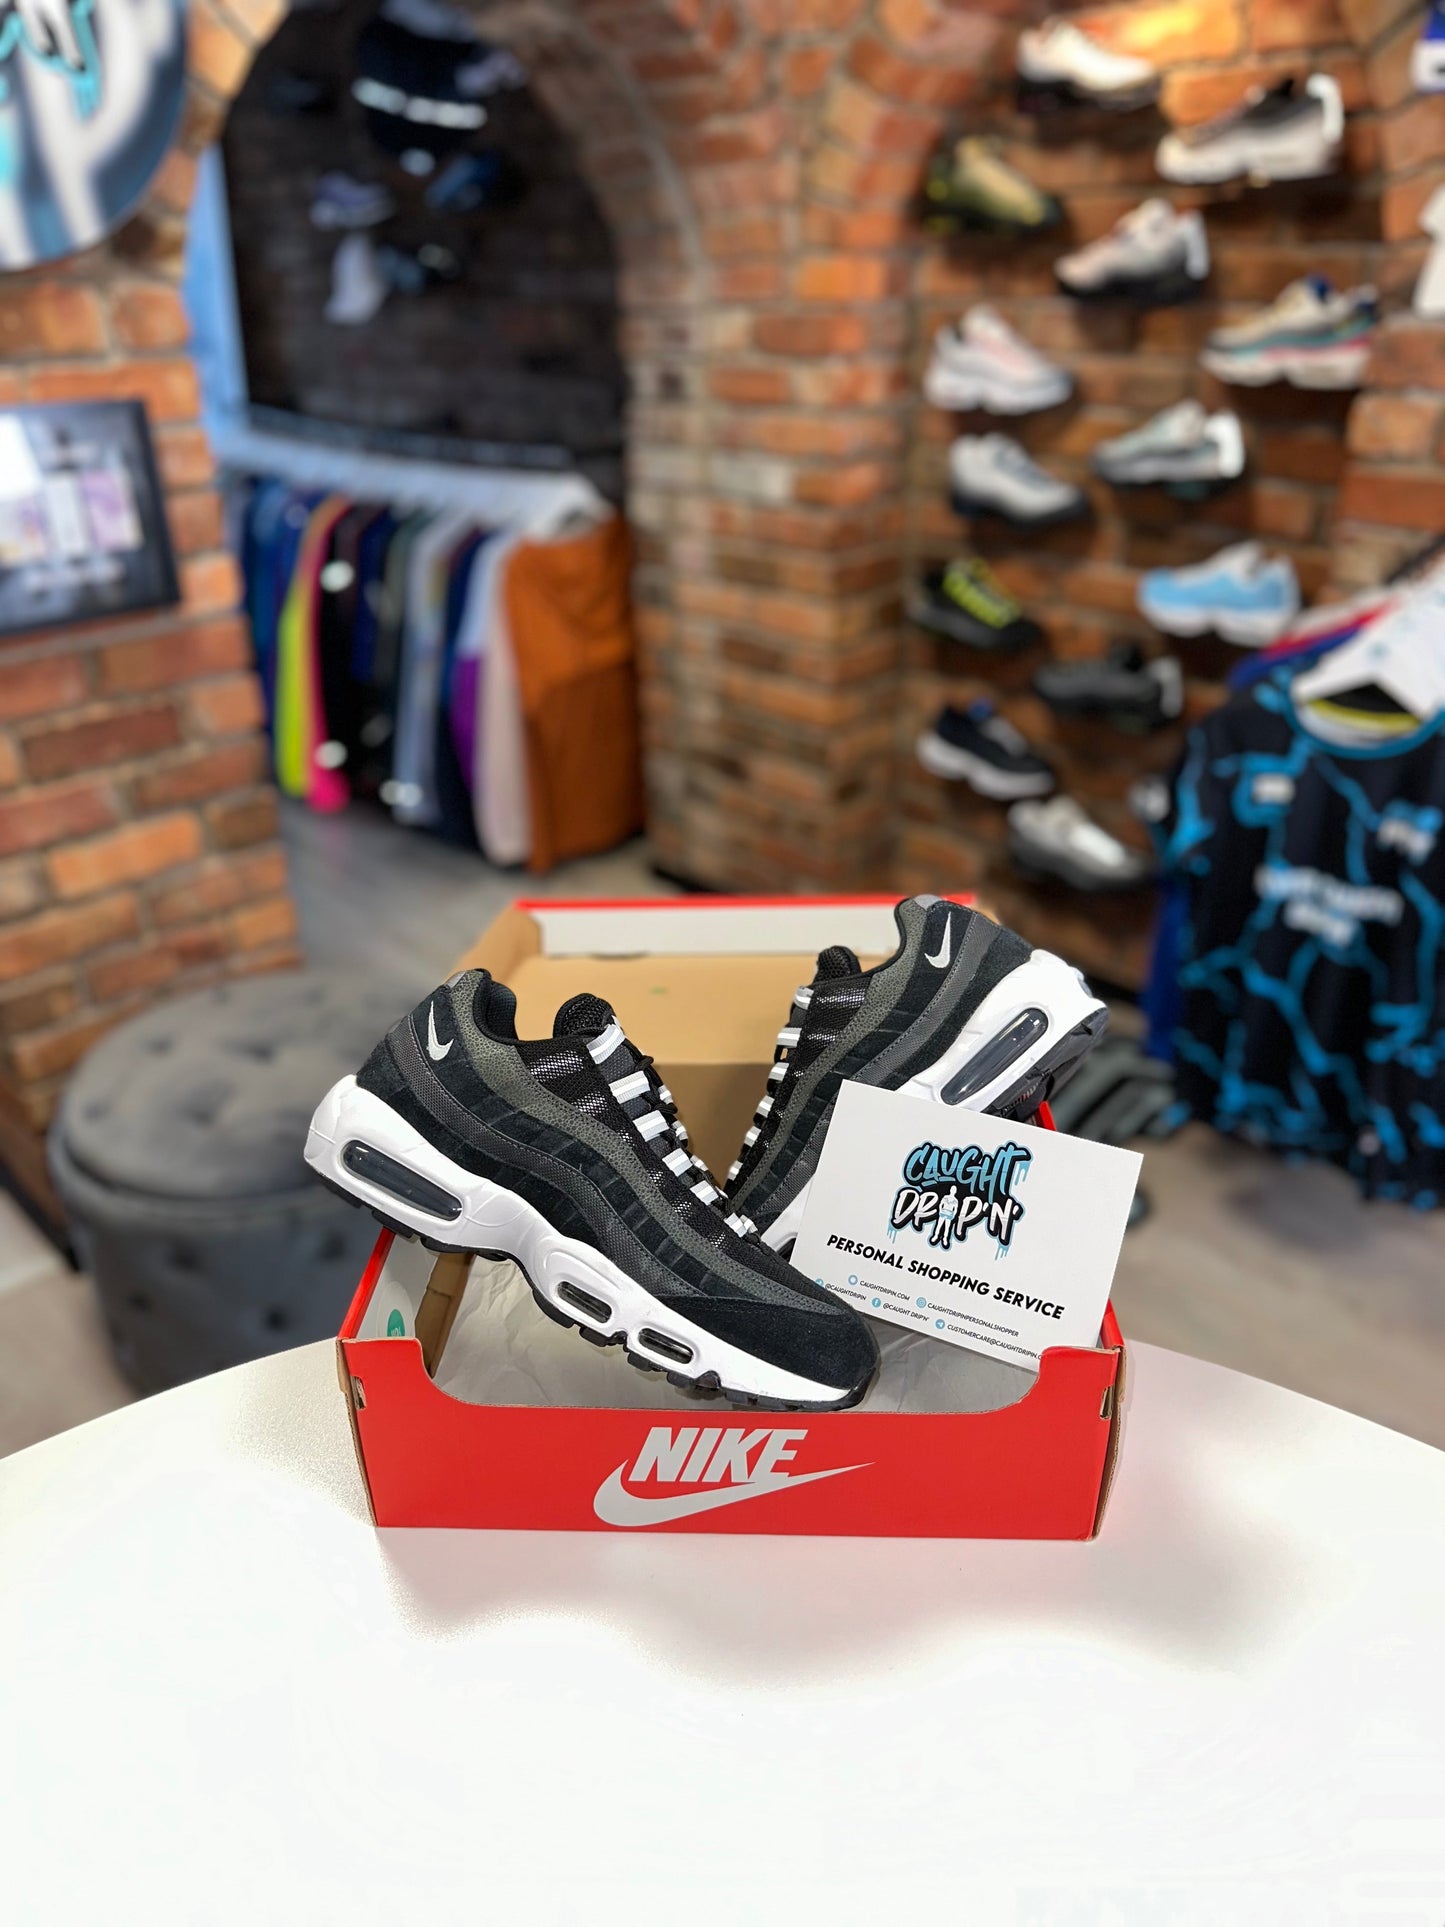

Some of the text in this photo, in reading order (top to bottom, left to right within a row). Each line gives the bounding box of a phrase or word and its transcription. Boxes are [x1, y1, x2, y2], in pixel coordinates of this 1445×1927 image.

[904, 1142, 1032, 1203] CAUGHT
[826, 1235, 1065, 1320] PERSONAL SHOPPING SERVICE
[859, 1280, 911, 1301] CAUGHTDRIPIN.COM
[882, 1302, 911, 1316] @CAUGHT
[628, 1426, 808, 1483] NIKE
